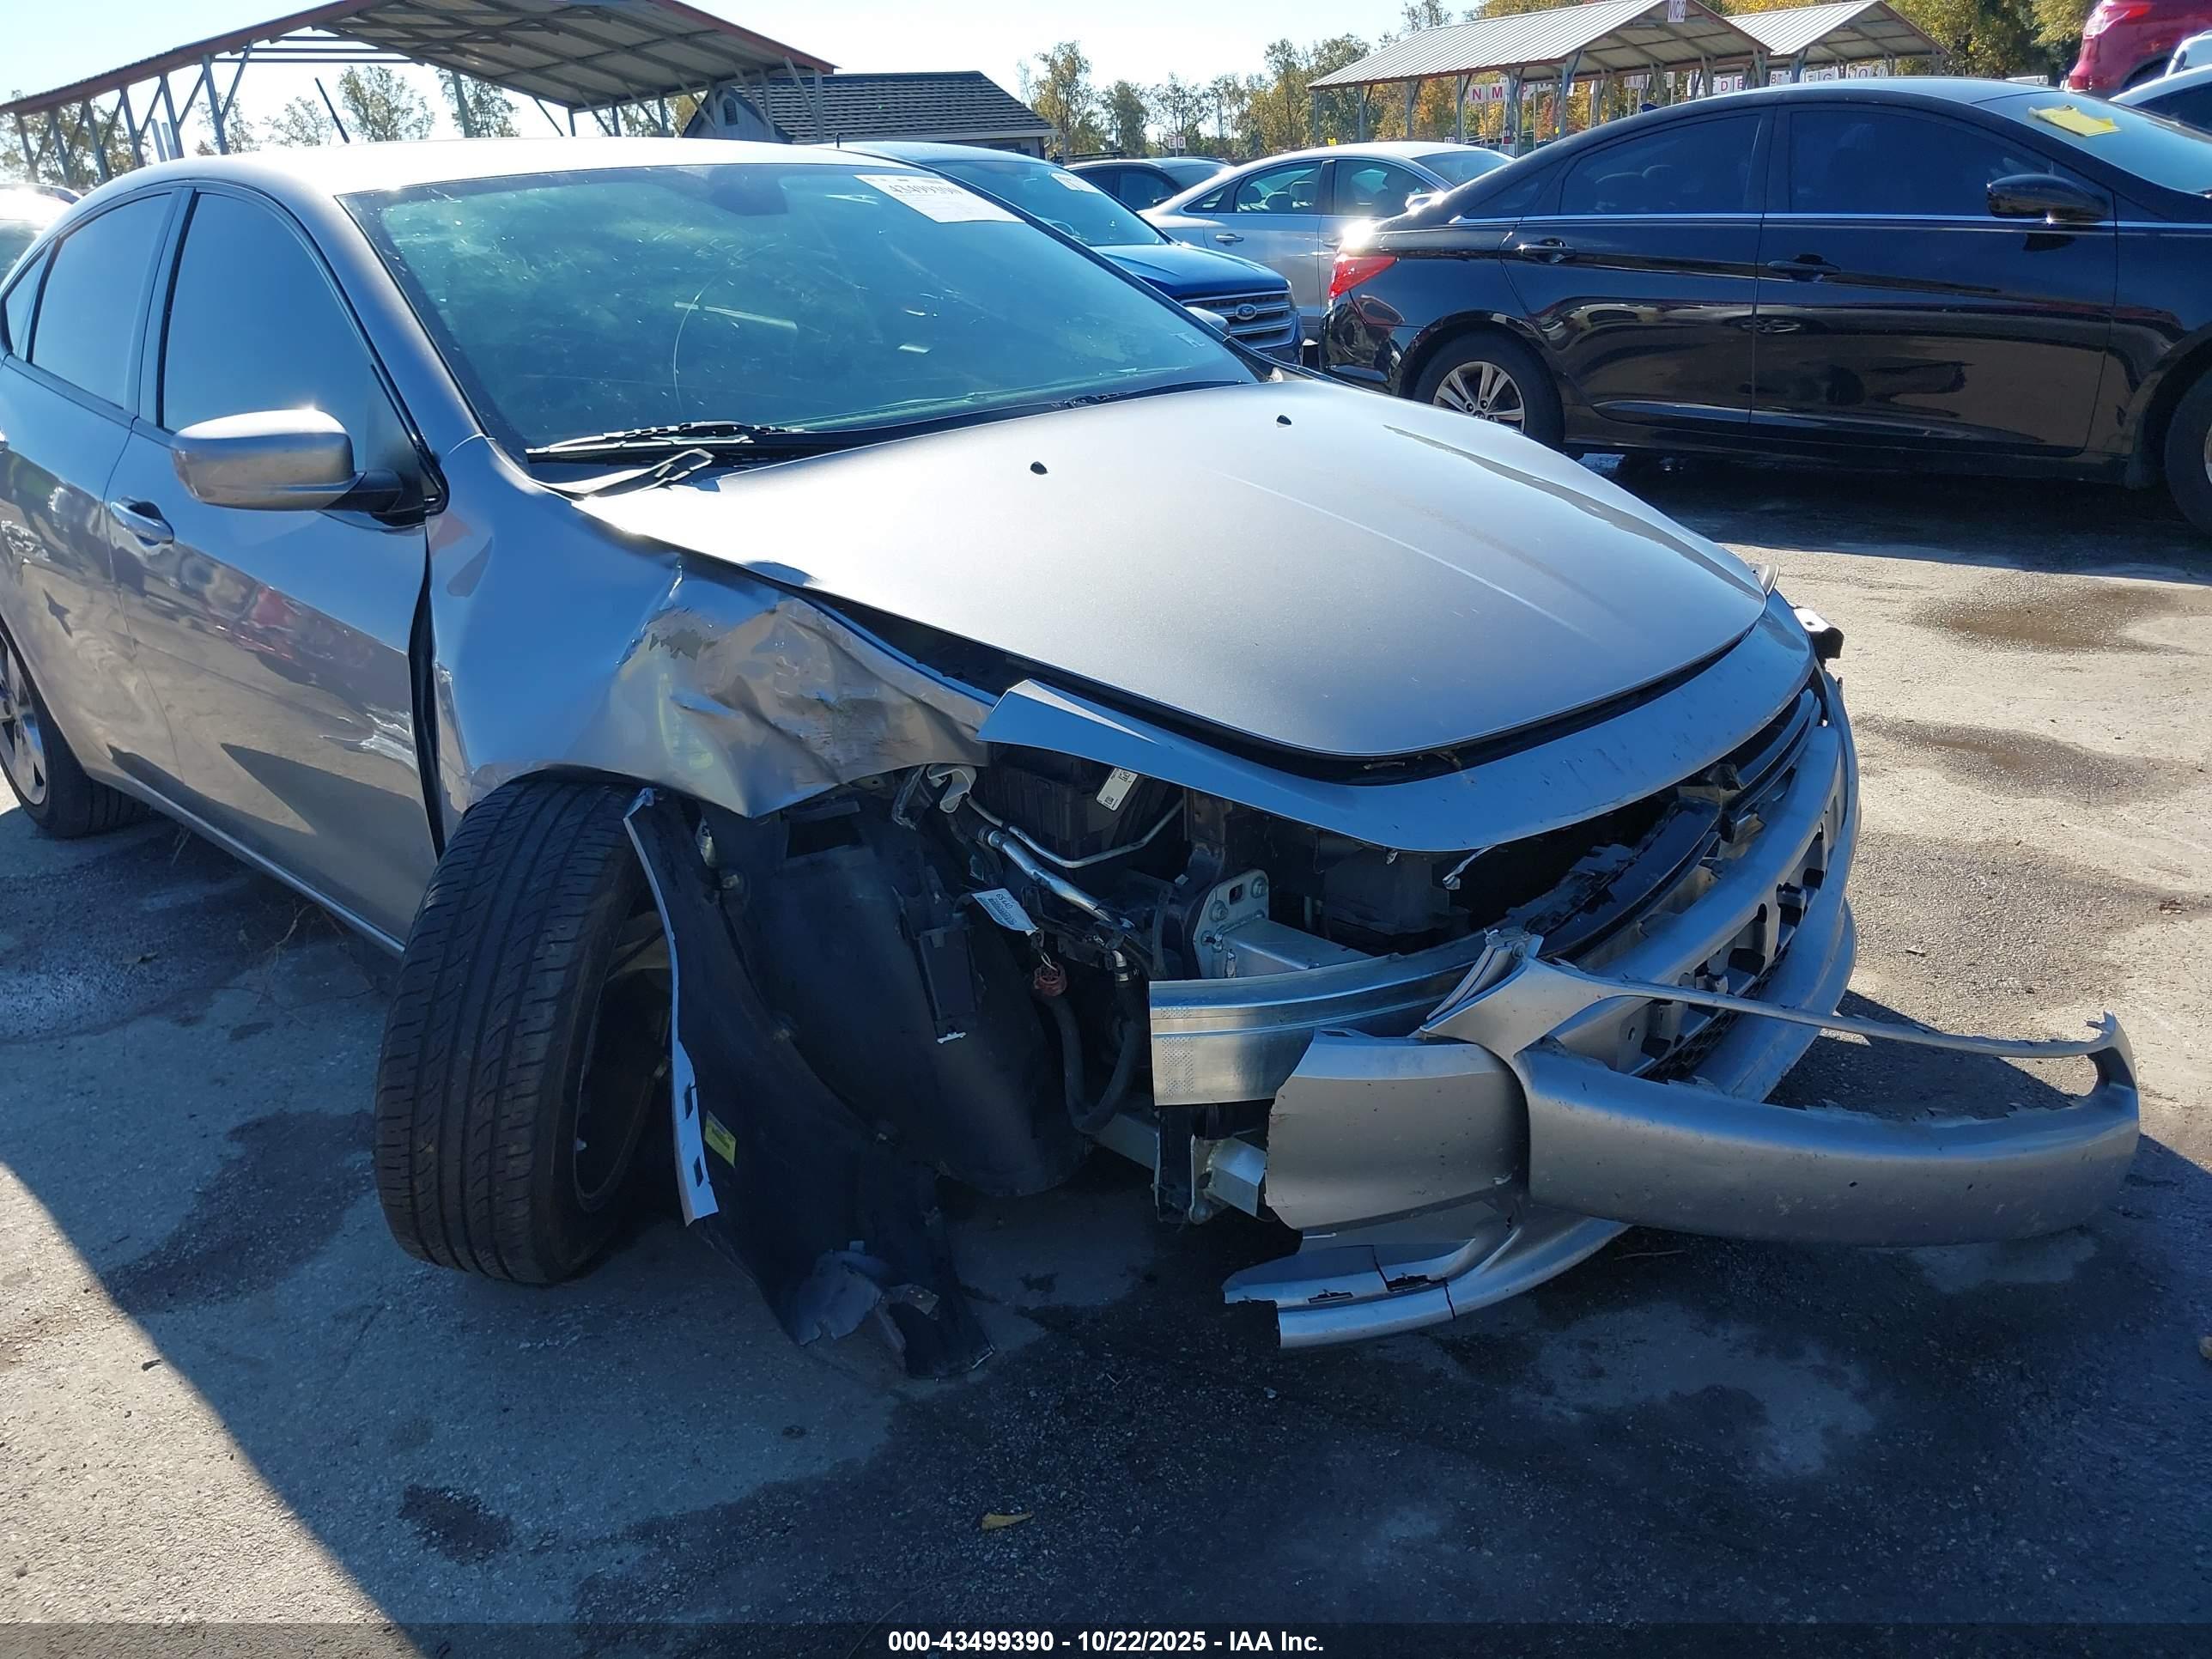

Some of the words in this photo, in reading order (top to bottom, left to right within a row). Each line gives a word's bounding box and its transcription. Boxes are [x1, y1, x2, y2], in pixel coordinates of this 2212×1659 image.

[1721, 81, 1728, 91] D
[1472, 88, 1481, 100] N
[1492, 87, 1503, 98] M
